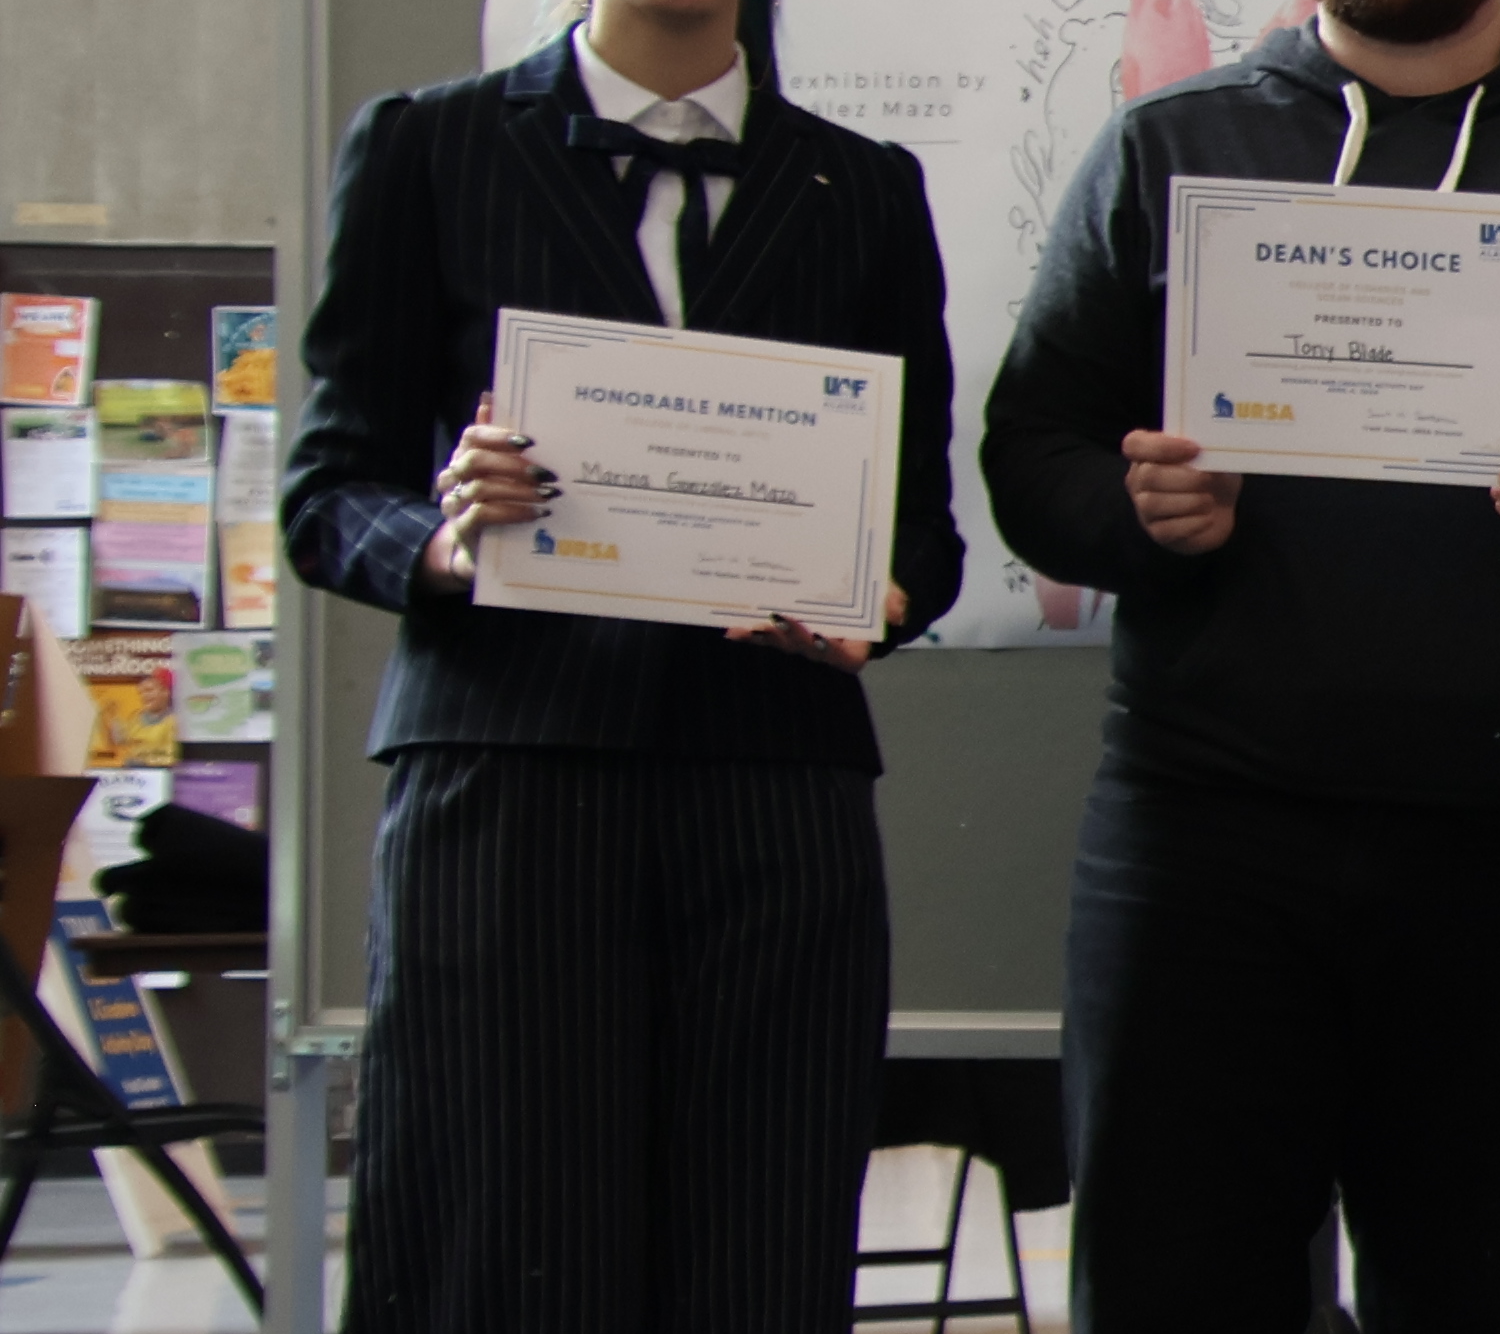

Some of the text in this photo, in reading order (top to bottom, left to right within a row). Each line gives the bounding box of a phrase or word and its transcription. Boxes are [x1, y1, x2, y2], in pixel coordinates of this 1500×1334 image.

[790, 73, 985, 91] exhibition by
[883, 102, 951, 117] Mazo
[1256, 243, 1460, 273] DEAN'S CHOICE
[1284, 335, 1335, 361] Tony
[575, 386, 816, 426] HONORABLE MENTION
[581, 461, 650, 488] Marina
